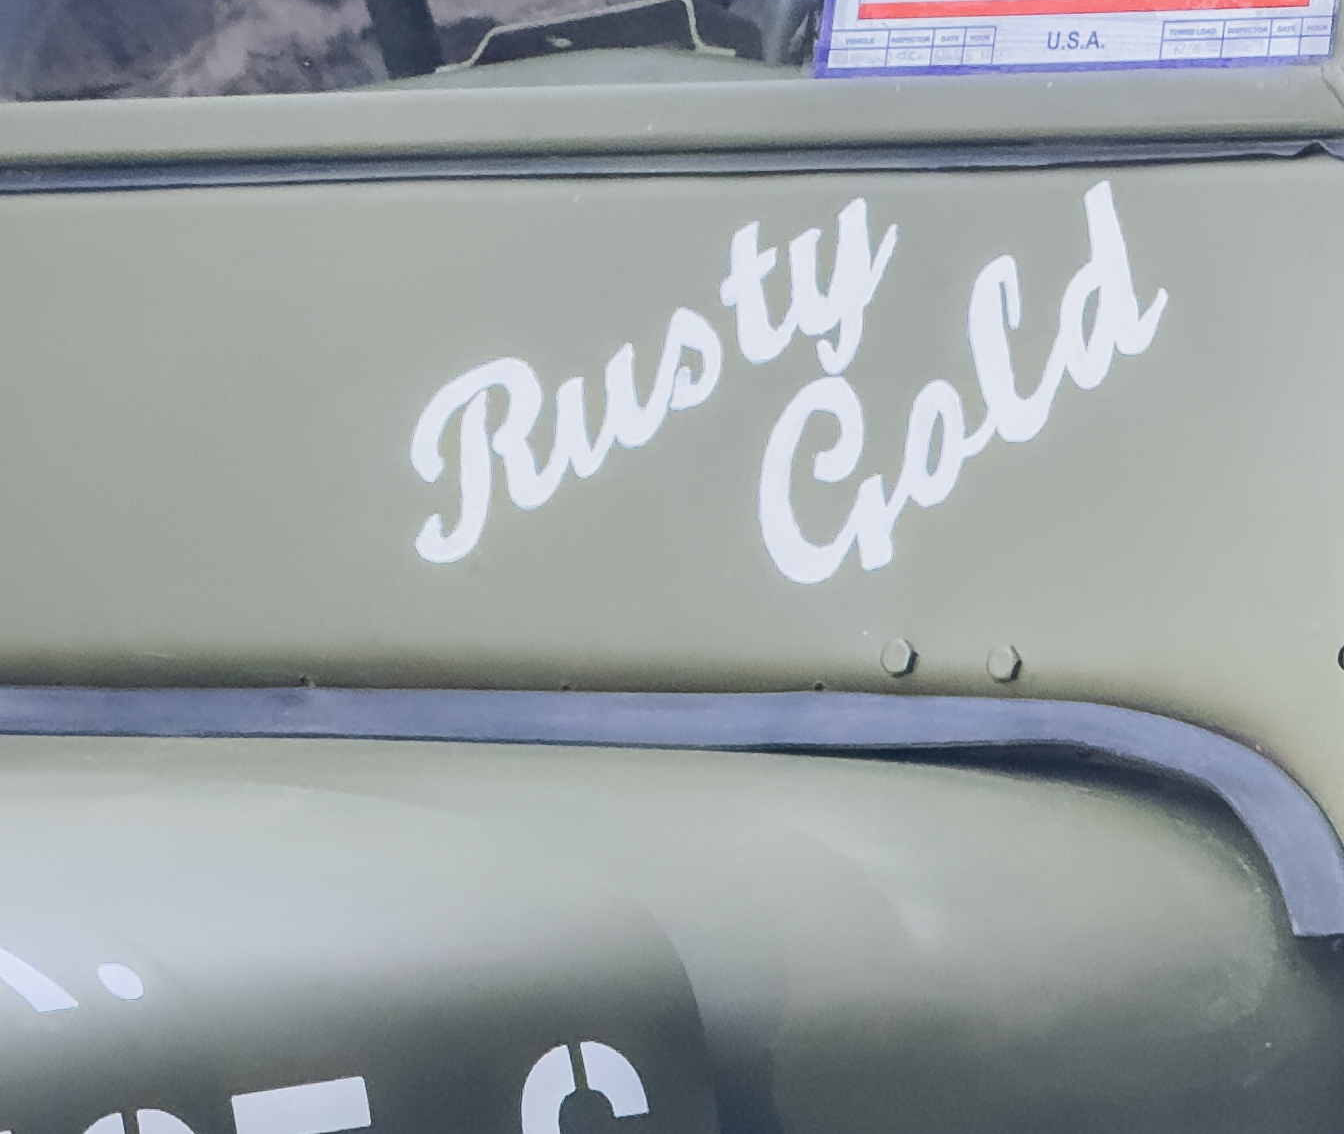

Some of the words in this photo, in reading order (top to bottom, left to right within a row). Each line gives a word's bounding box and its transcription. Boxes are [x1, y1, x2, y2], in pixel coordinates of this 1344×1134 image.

[1047, 30, 1105, 50] U.S.A.
[410, 197, 897, 563] Rusty
[758, 180, 1168, 584] Gold
